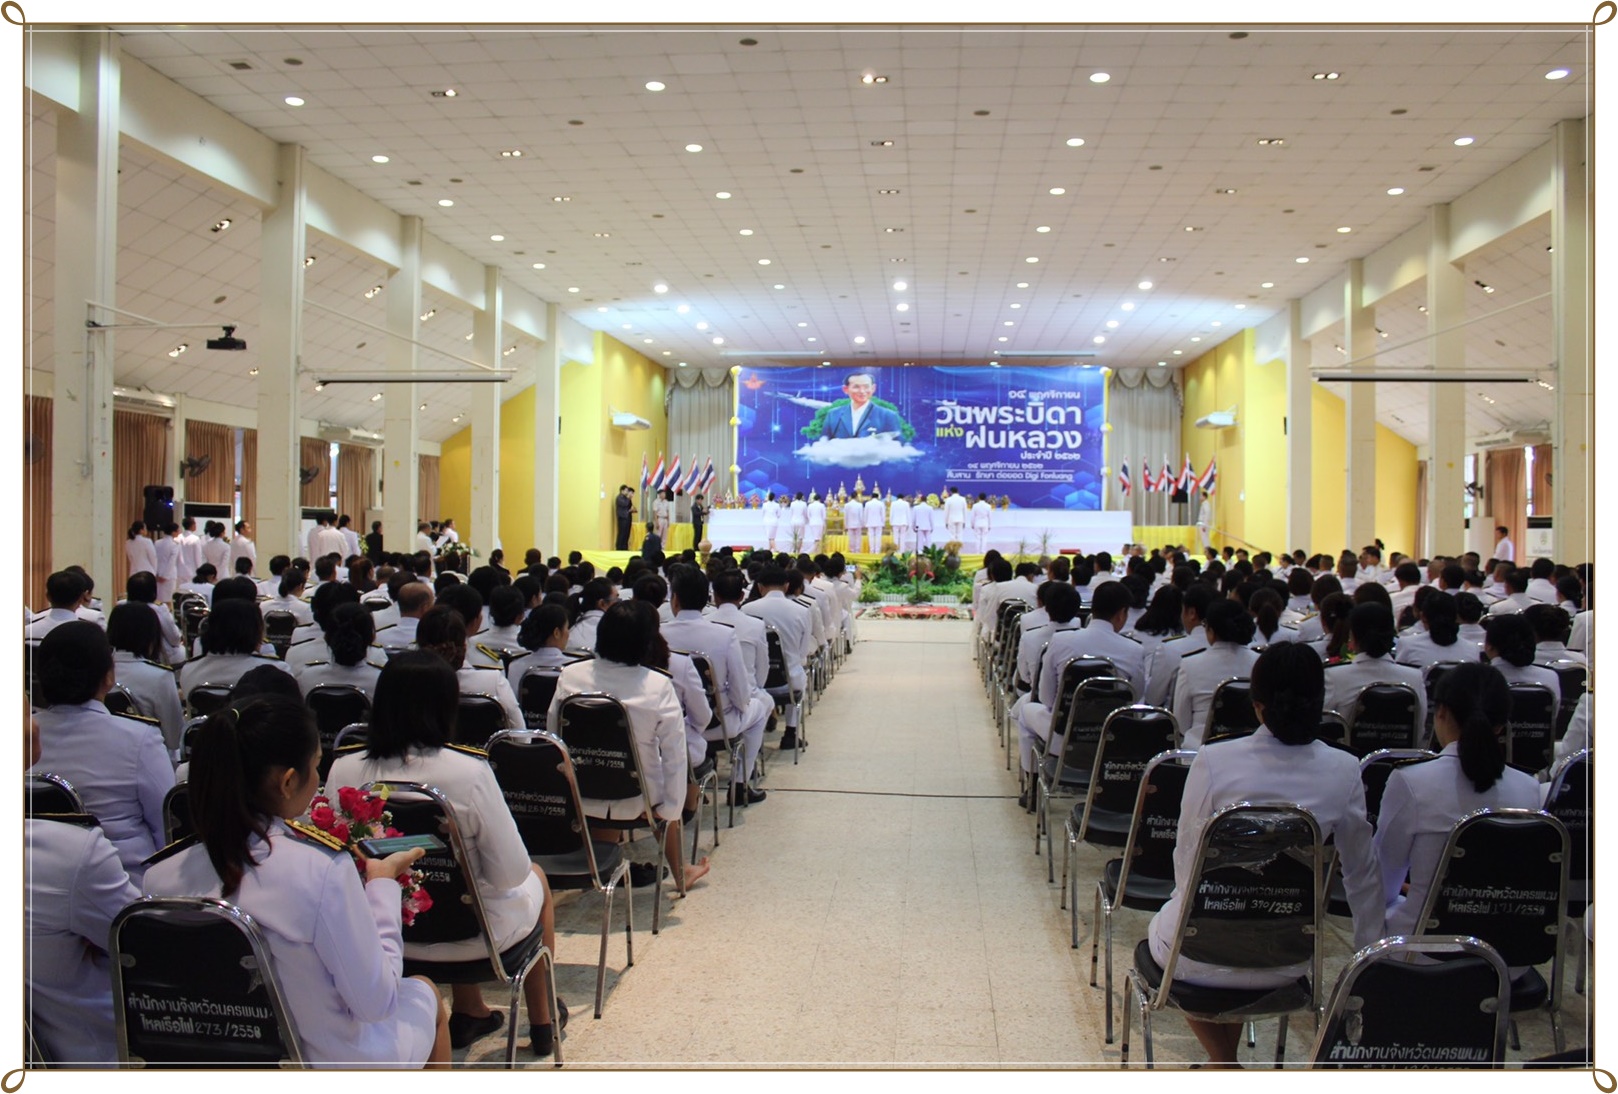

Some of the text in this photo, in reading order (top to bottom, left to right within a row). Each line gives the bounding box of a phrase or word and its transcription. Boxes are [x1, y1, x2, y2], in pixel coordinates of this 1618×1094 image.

[1028, 389, 1081, 400] พฤศจิกายน
[936, 399, 1082, 425] วันพระบิดา
[935, 424, 964, 438] แห่ง
[965, 425, 1082, 449] ฝนหลวง
[1020, 450, 1052, 460] ประจำปี
